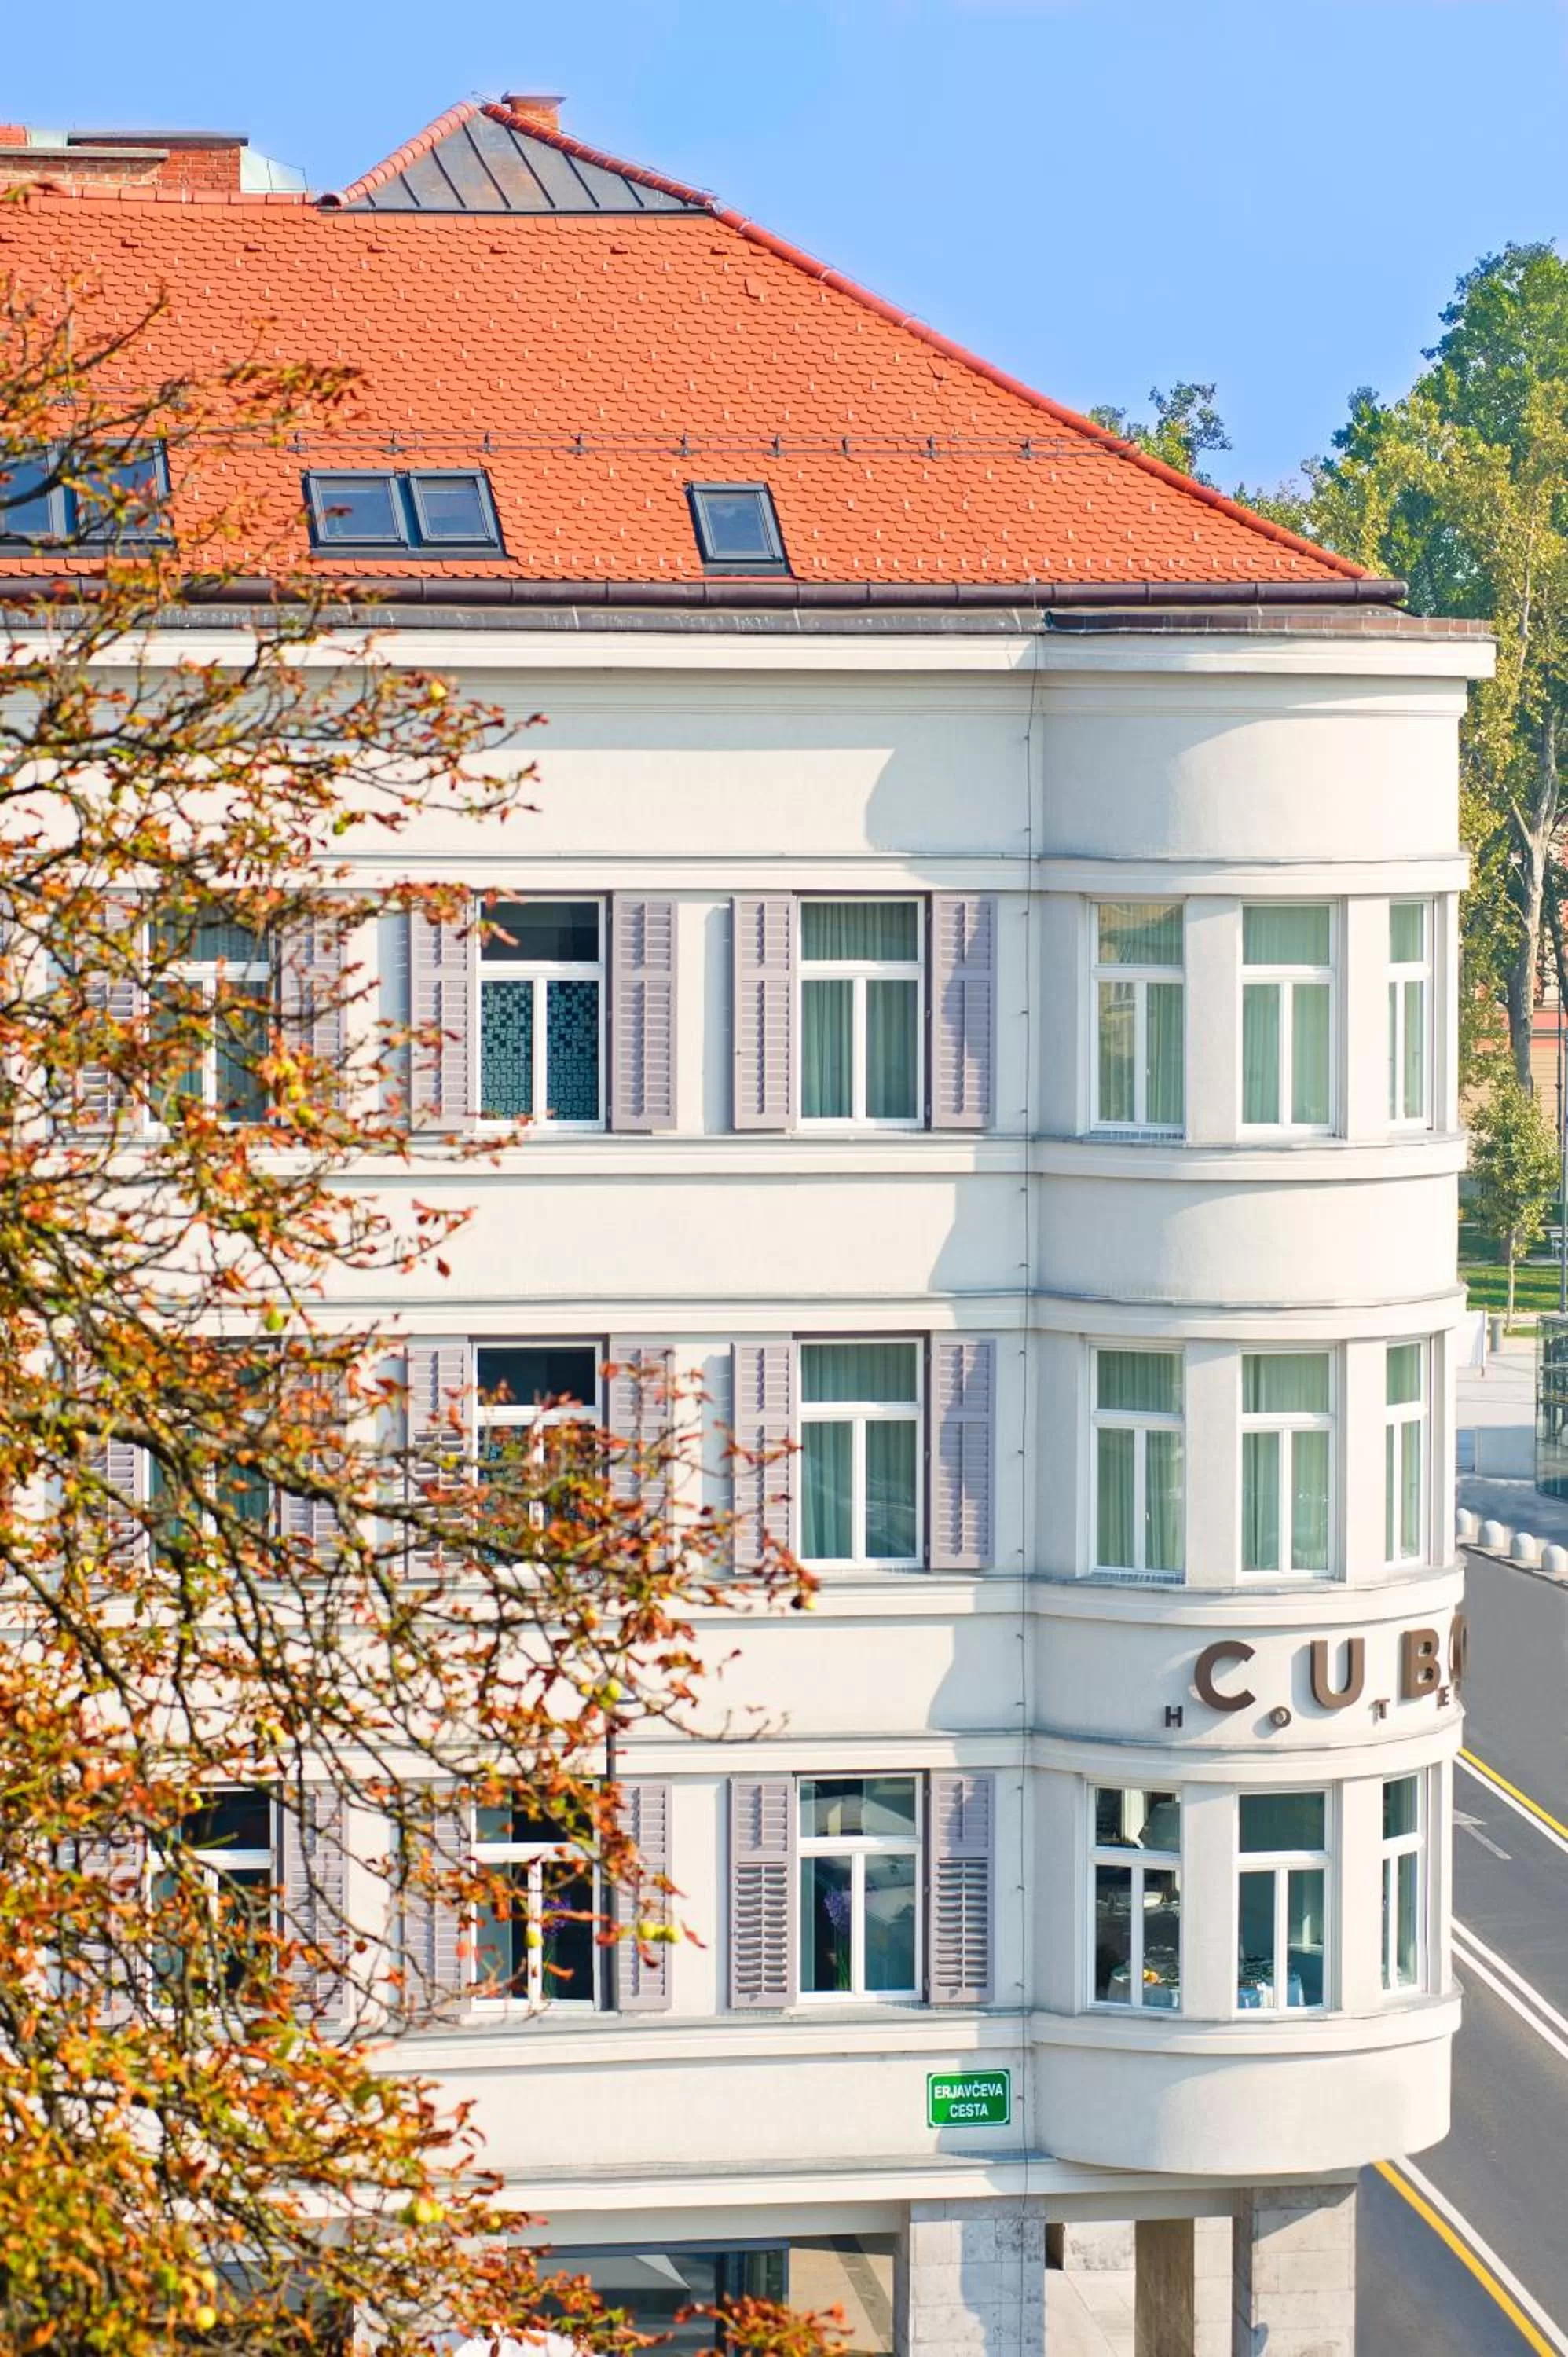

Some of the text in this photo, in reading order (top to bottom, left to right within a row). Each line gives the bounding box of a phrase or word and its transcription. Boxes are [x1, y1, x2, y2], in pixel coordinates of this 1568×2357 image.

[1164, 1685, 1450, 1728] HOTE
[934, 2080, 1003, 2099] ERJAVČEVA
[950, 2103, 988, 2117] CESTA
